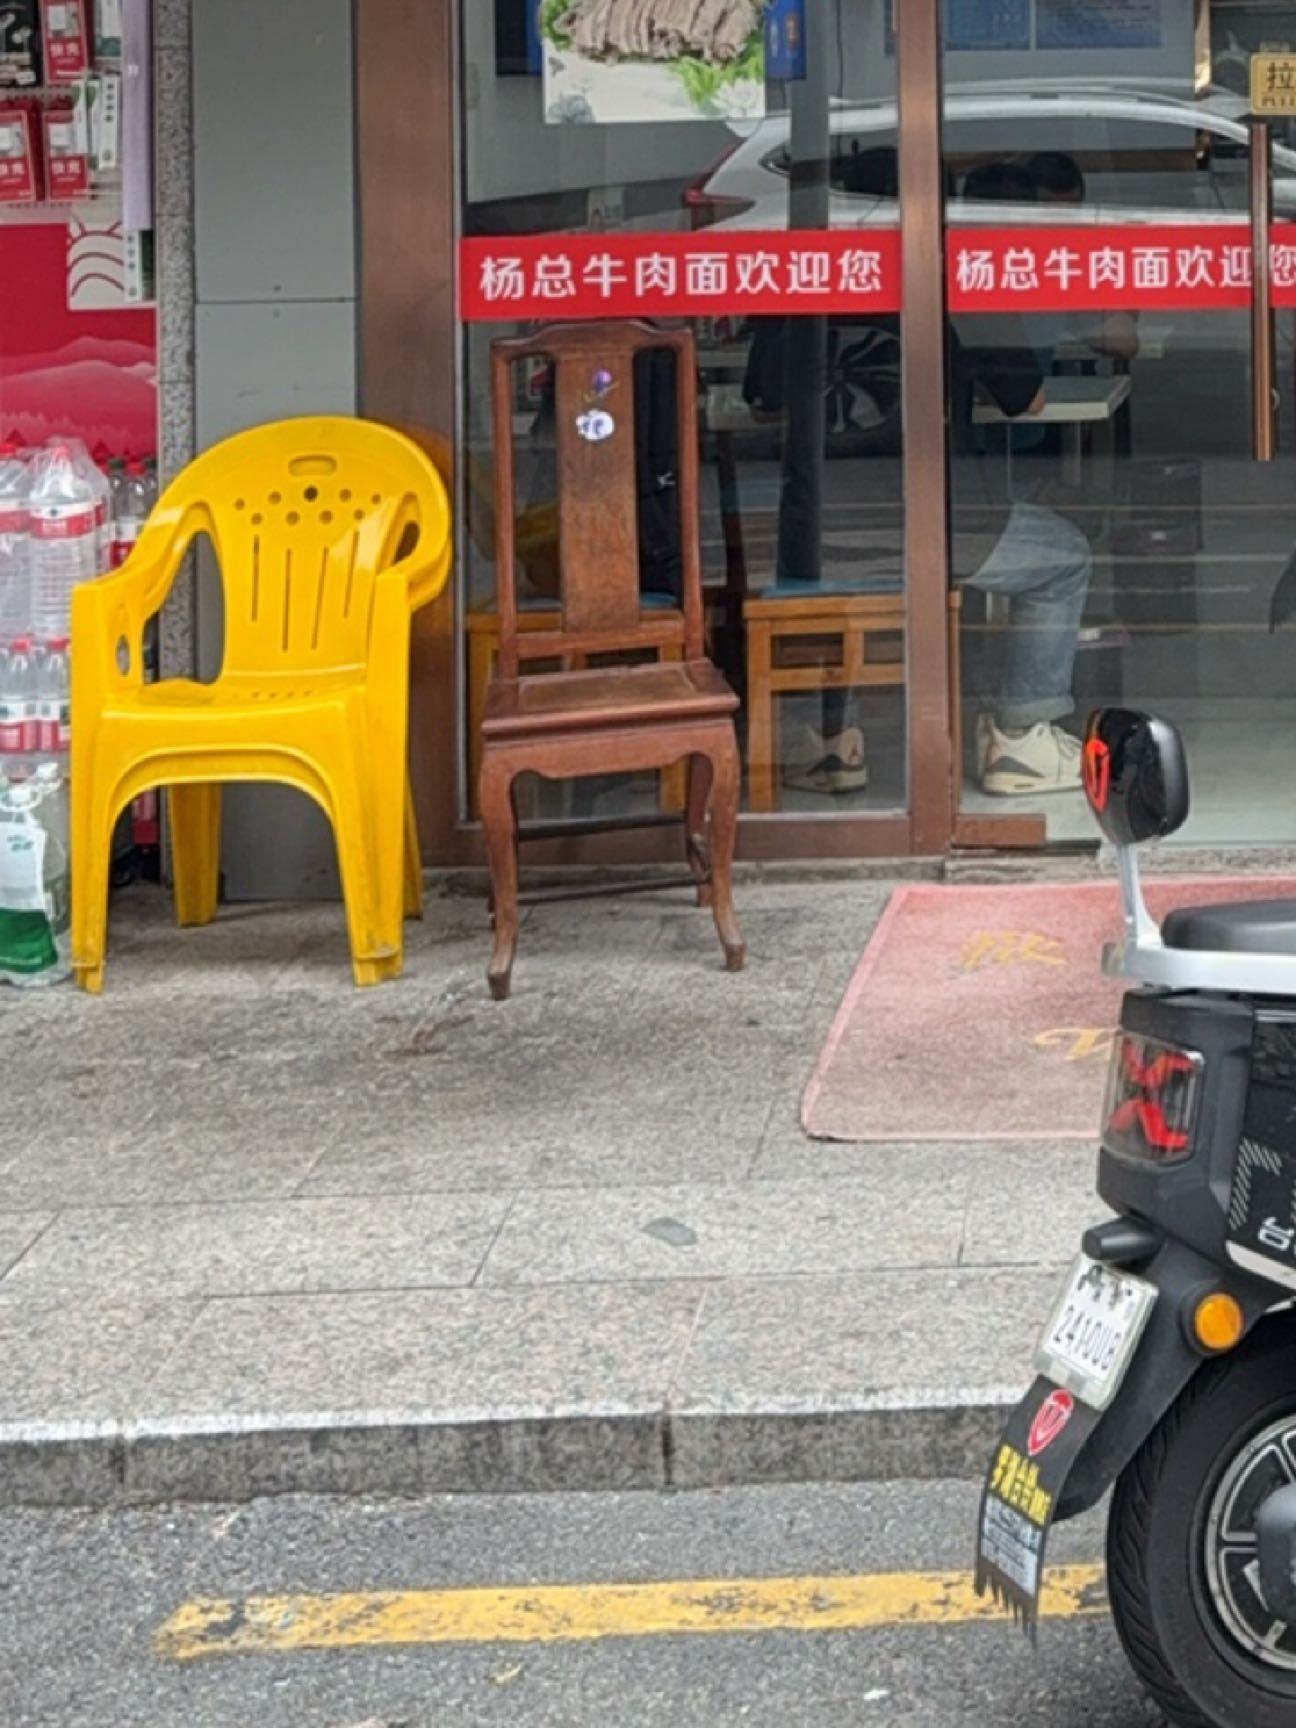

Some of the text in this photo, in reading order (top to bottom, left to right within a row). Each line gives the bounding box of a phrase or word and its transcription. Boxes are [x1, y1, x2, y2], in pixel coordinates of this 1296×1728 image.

[1266, 61, 1296, 92] 拉
[479, 248, 883, 303] 杨总牛肉面欢迎您
